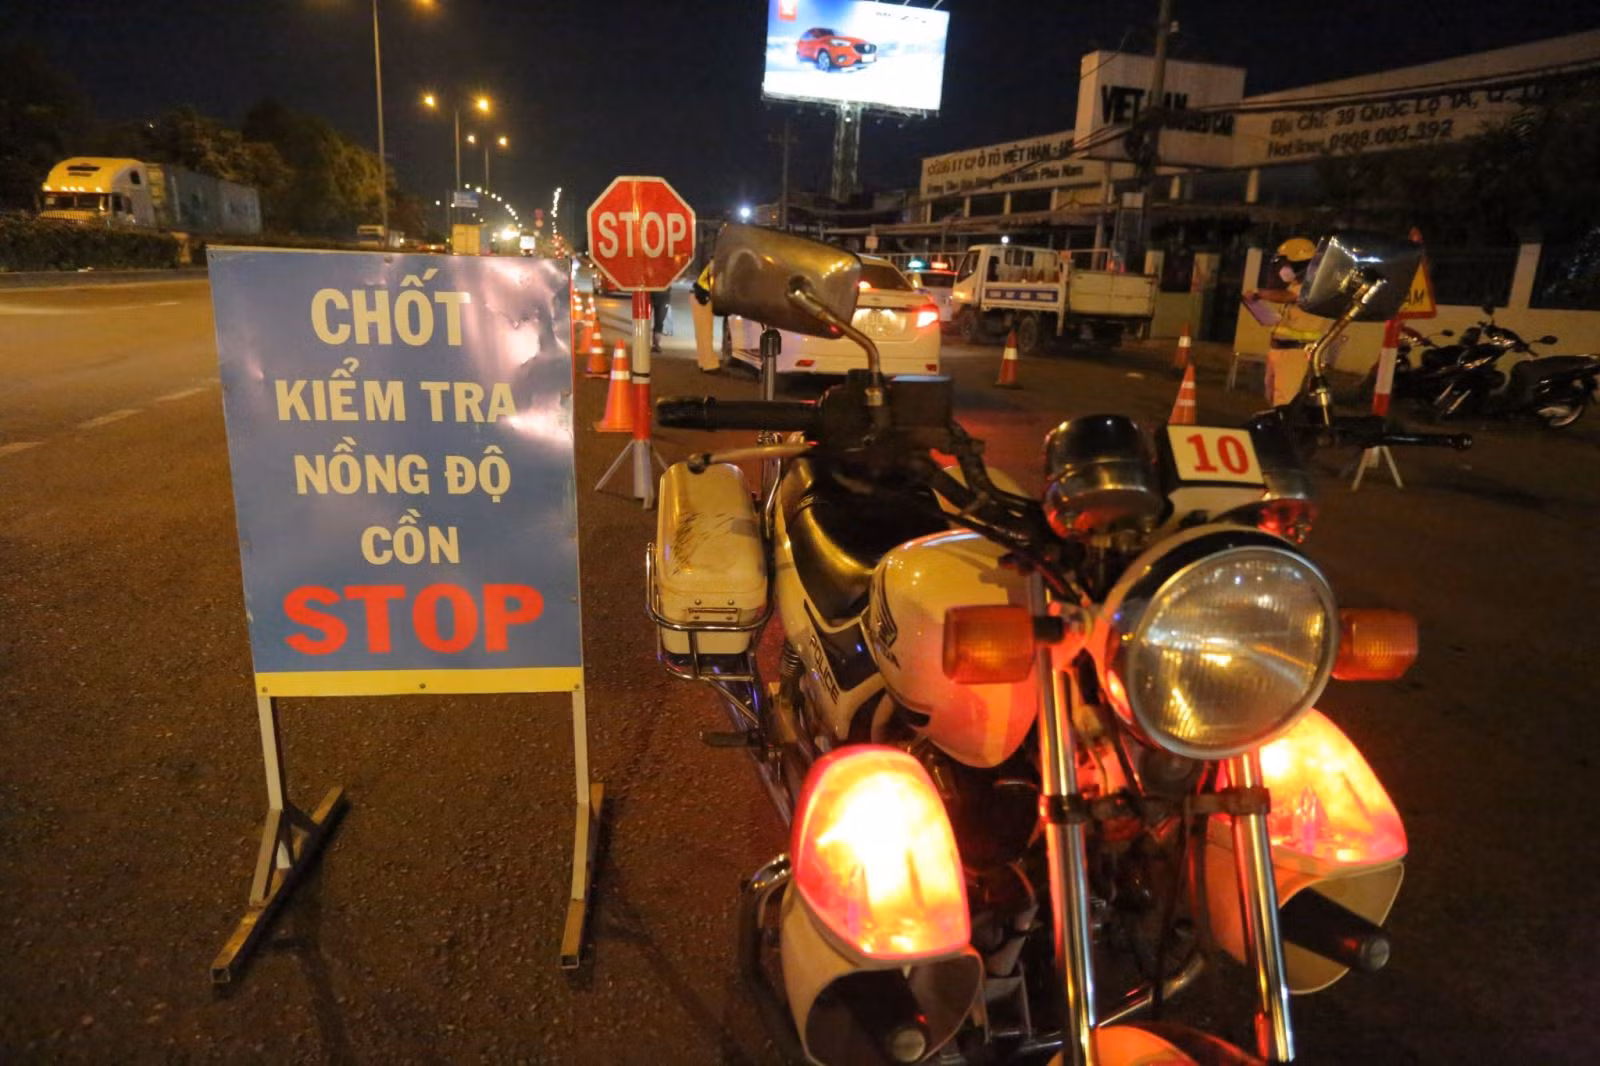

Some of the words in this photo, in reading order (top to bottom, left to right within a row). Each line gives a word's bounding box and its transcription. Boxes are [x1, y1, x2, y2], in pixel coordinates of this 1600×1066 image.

[1335, 107, 1355, 126] 39
[1360, 101, 1411, 122] Quốc
[1415, 95, 1440, 116] Lộ
[598, 210, 687, 258] STOP
[310, 268, 471, 346] CHỐT
[274, 357, 406, 421] KIỂM
[419, 381, 518, 422] TRA
[293, 436, 430, 495] NỒNG
[444, 445, 511, 503] ĐỘ
[1186, 432, 1249, 475] 10
[360, 508, 460, 565] CỒN
[282, 583, 545, 655] STOP
[808, 635, 840, 706] POLICE
